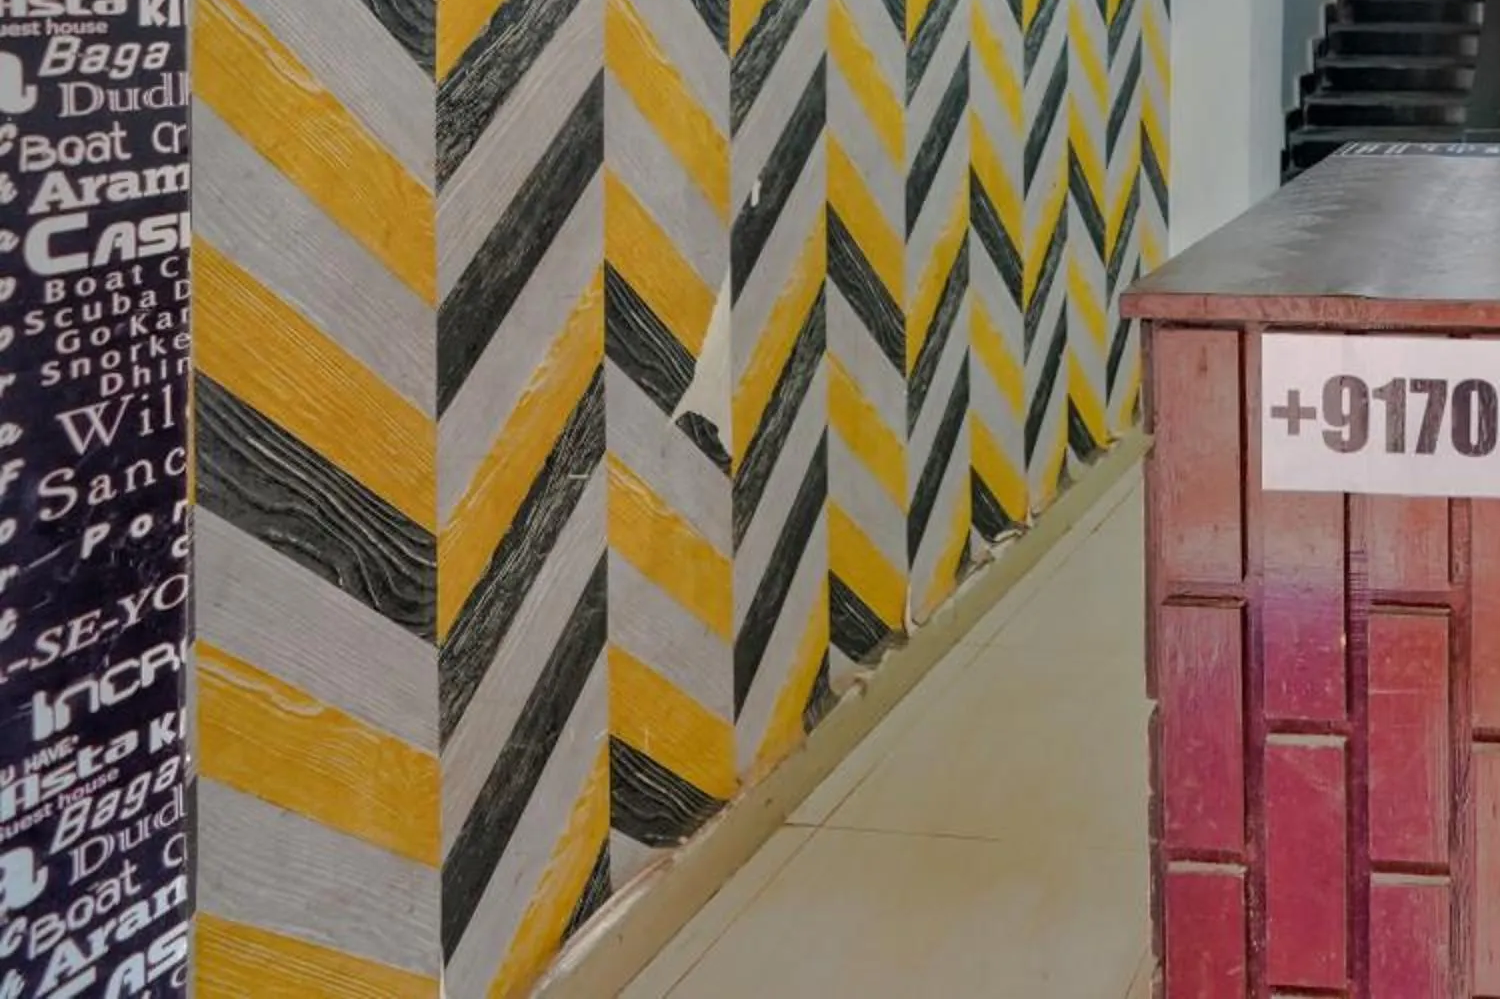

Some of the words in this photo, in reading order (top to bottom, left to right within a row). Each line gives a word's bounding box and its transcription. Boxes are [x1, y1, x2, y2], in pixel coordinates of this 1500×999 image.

[38, 35, 171, 80] Baga
[19, 120, 132, 173] Boat
[45, 263, 145, 306] Boat
[24, 289, 157, 336] Scuba
[55, 325, 112, 356] Go
[50, 756, 181, 855] Baga
[27, 859, 142, 961] Boat
